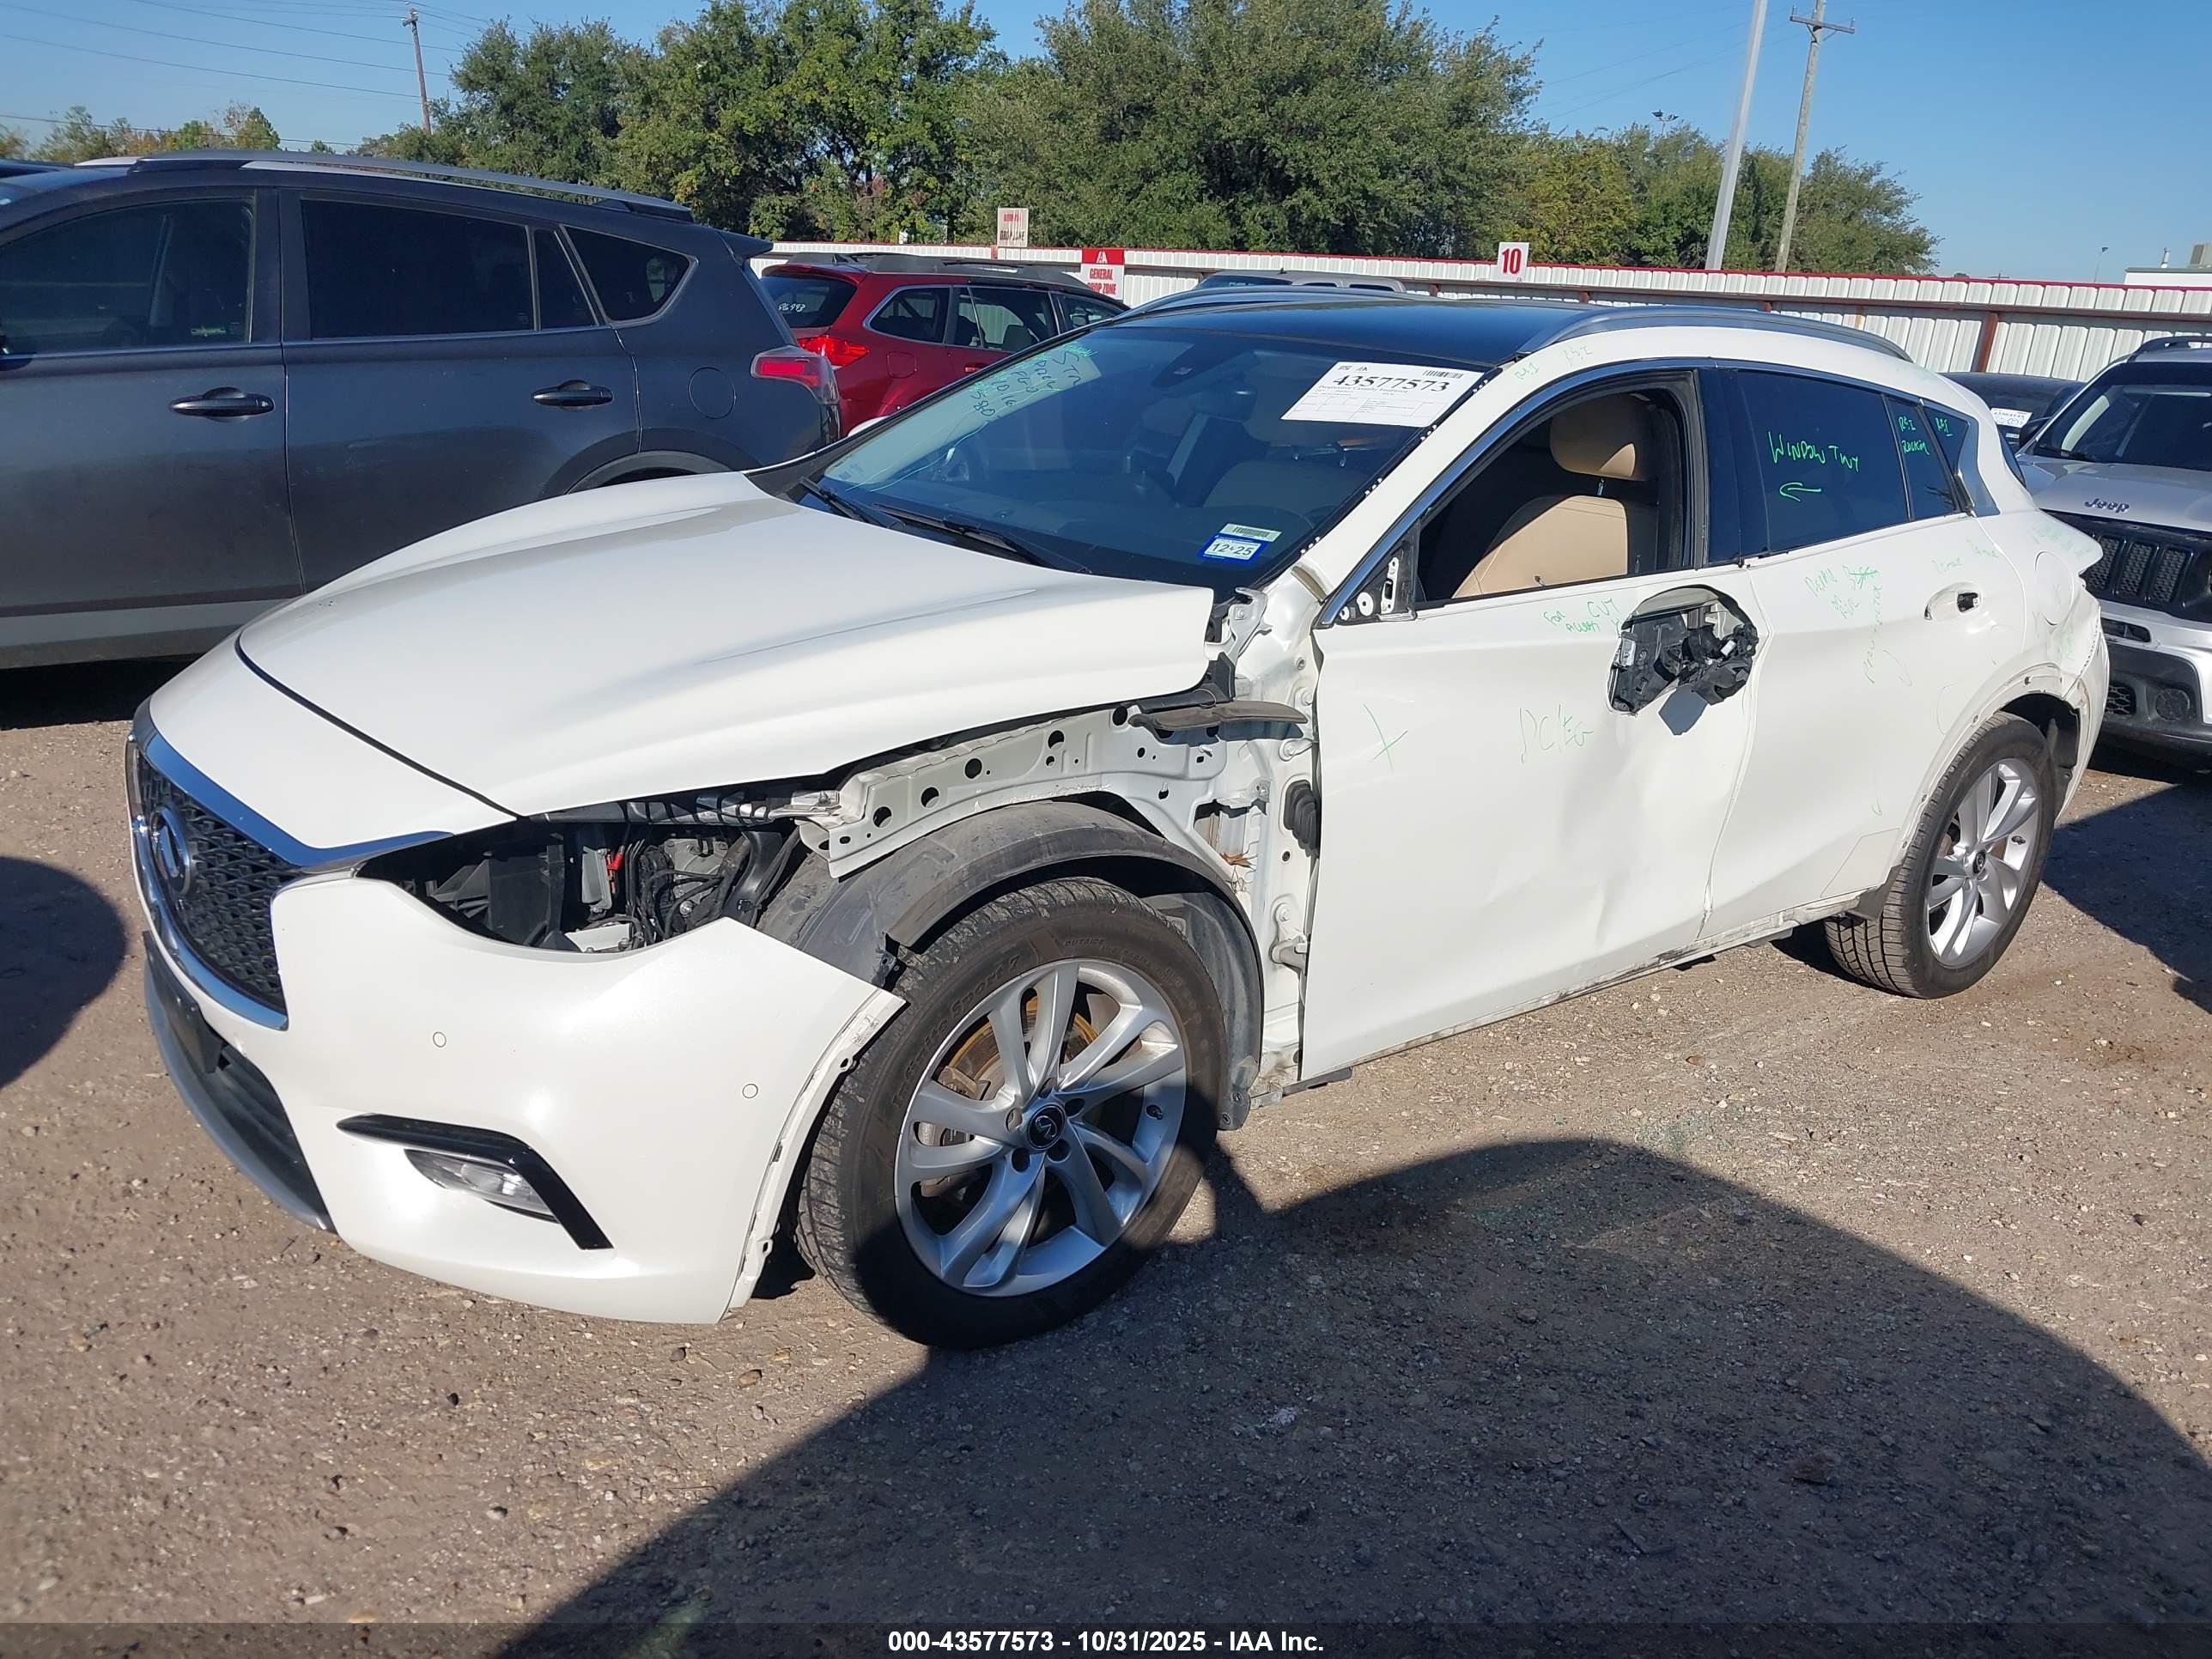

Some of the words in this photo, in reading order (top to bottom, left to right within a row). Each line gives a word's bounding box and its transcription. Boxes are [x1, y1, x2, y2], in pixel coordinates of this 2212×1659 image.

[1501, 248, 1522, 274] 10
[1090, 268, 1113, 280] GENERAL
[1103, 283, 1117, 295] ZONE
[1333, 374, 1450, 392] 43577573
[1768, 430, 1826, 464] WINDOW
[2084, 498, 2130, 513] Jeep
